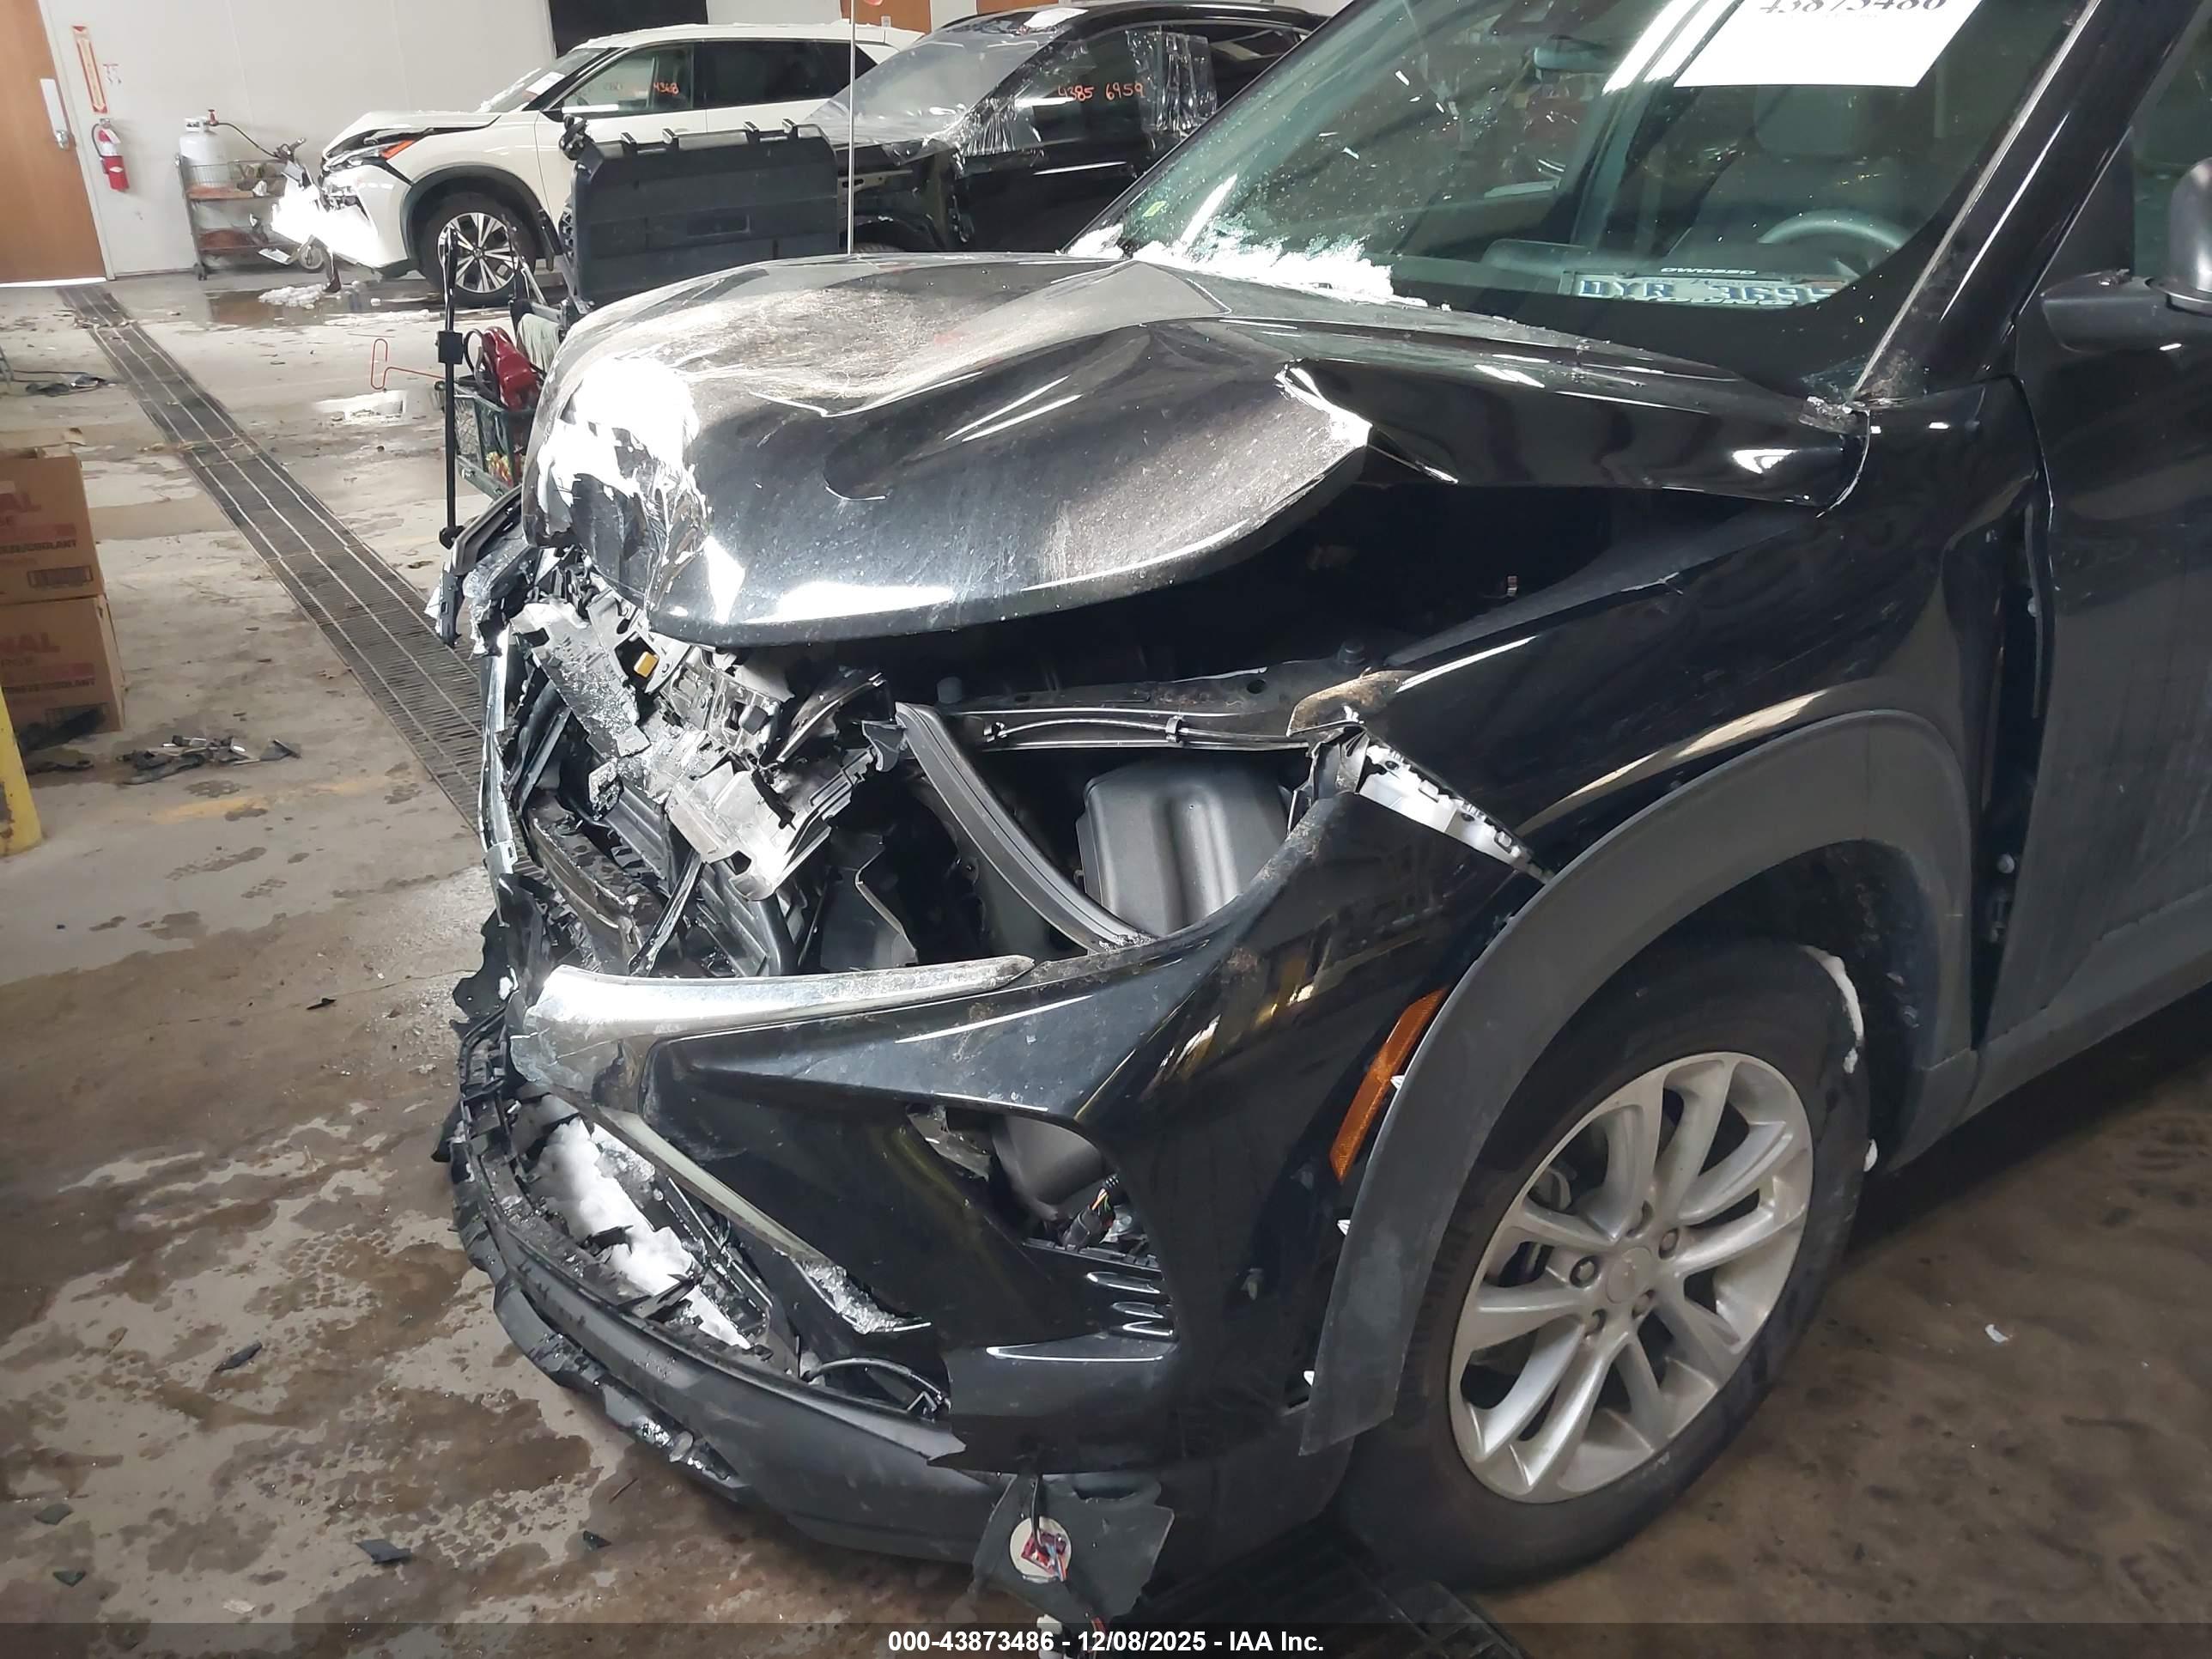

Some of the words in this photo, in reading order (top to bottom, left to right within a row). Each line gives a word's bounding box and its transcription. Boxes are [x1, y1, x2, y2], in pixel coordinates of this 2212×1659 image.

[1057, 84, 1095, 102] 4385
[1105, 82, 1146, 101] 6959
[1577, 280, 1674, 299] DYR
